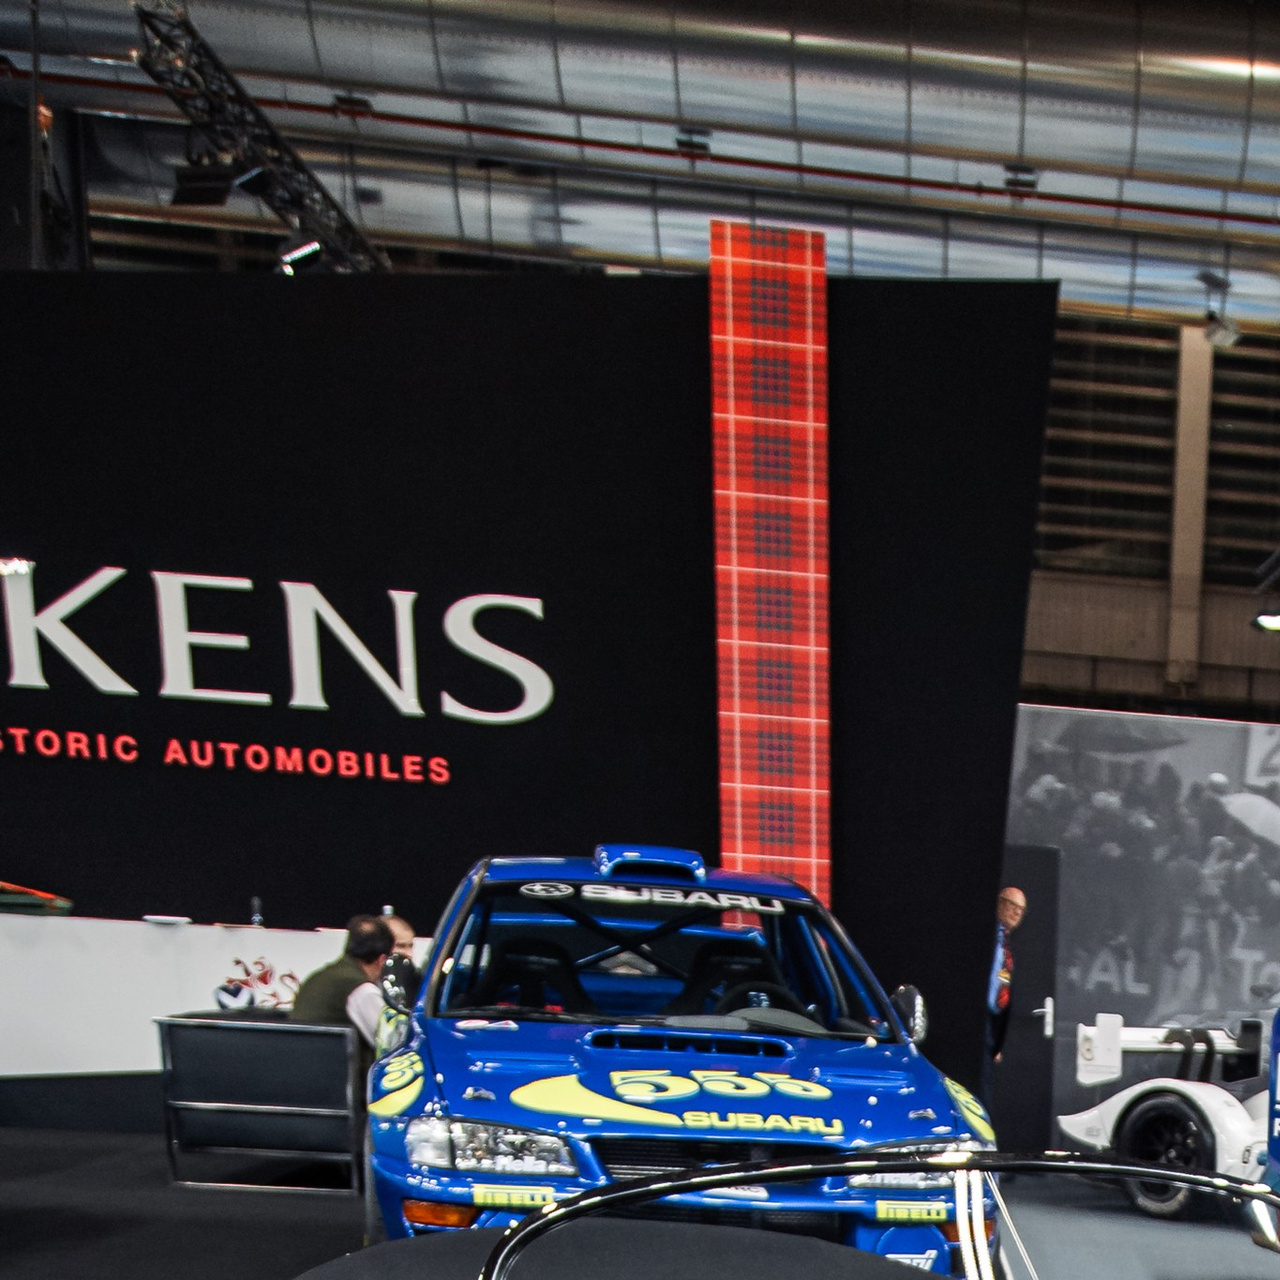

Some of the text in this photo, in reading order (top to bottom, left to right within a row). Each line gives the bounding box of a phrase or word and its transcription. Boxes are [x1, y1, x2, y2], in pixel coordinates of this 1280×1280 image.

[164, 737, 451, 784] AUTOMOBILES
[581, 883, 785, 915] SUBARU
[609, 1069, 832, 1103] 555
[682, 1110, 844, 1136] SUBARU
